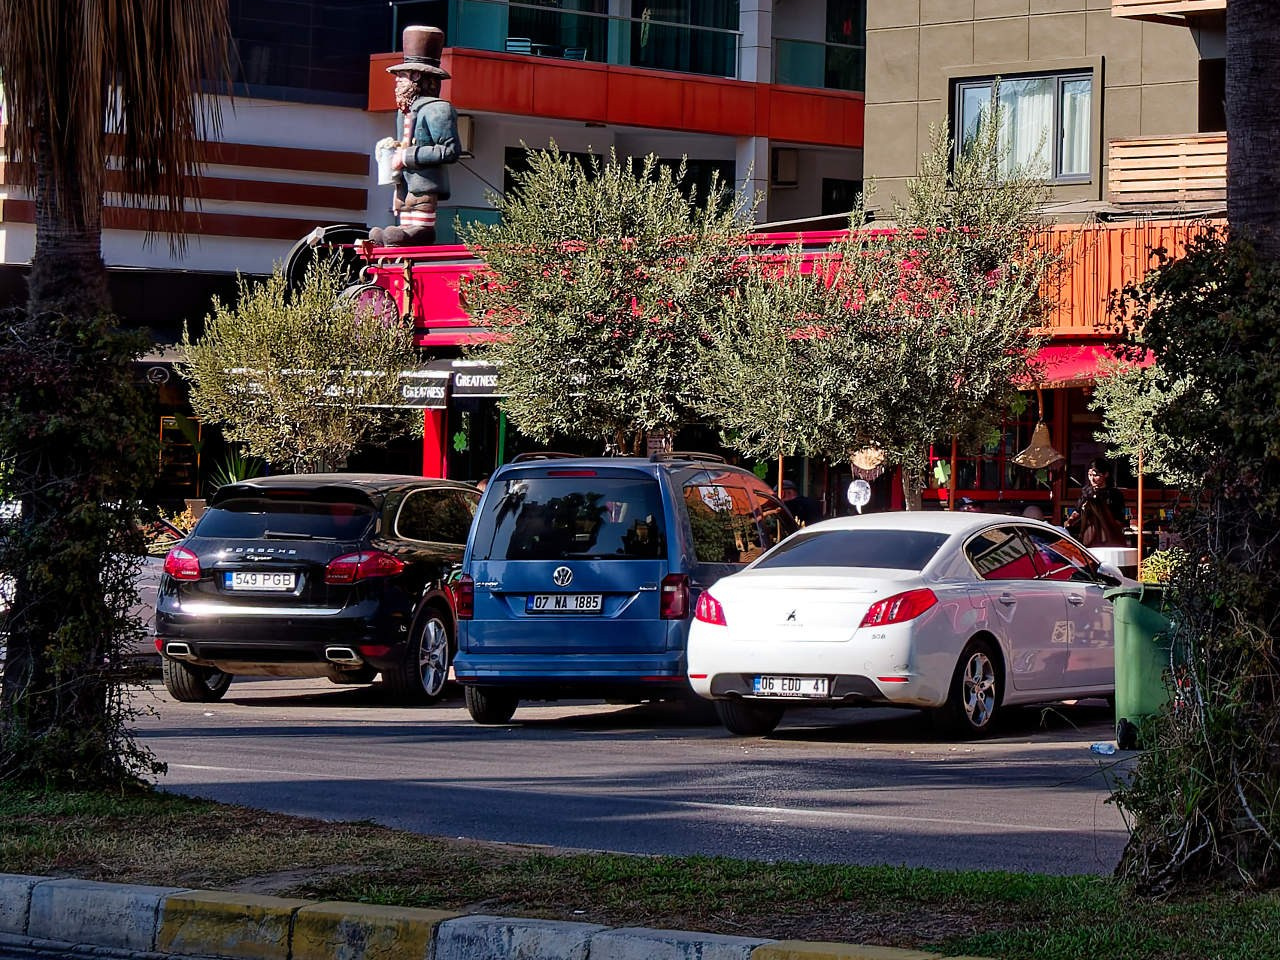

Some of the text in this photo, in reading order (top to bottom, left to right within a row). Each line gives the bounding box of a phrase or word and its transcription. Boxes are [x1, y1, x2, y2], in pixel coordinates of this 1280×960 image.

[225, 547, 297, 555] PORSCHE
[235, 572, 292, 586] 549 PGB
[535, 595, 599, 609] 07 NA 1885
[761, 677, 825, 692] 06 EDD 41
